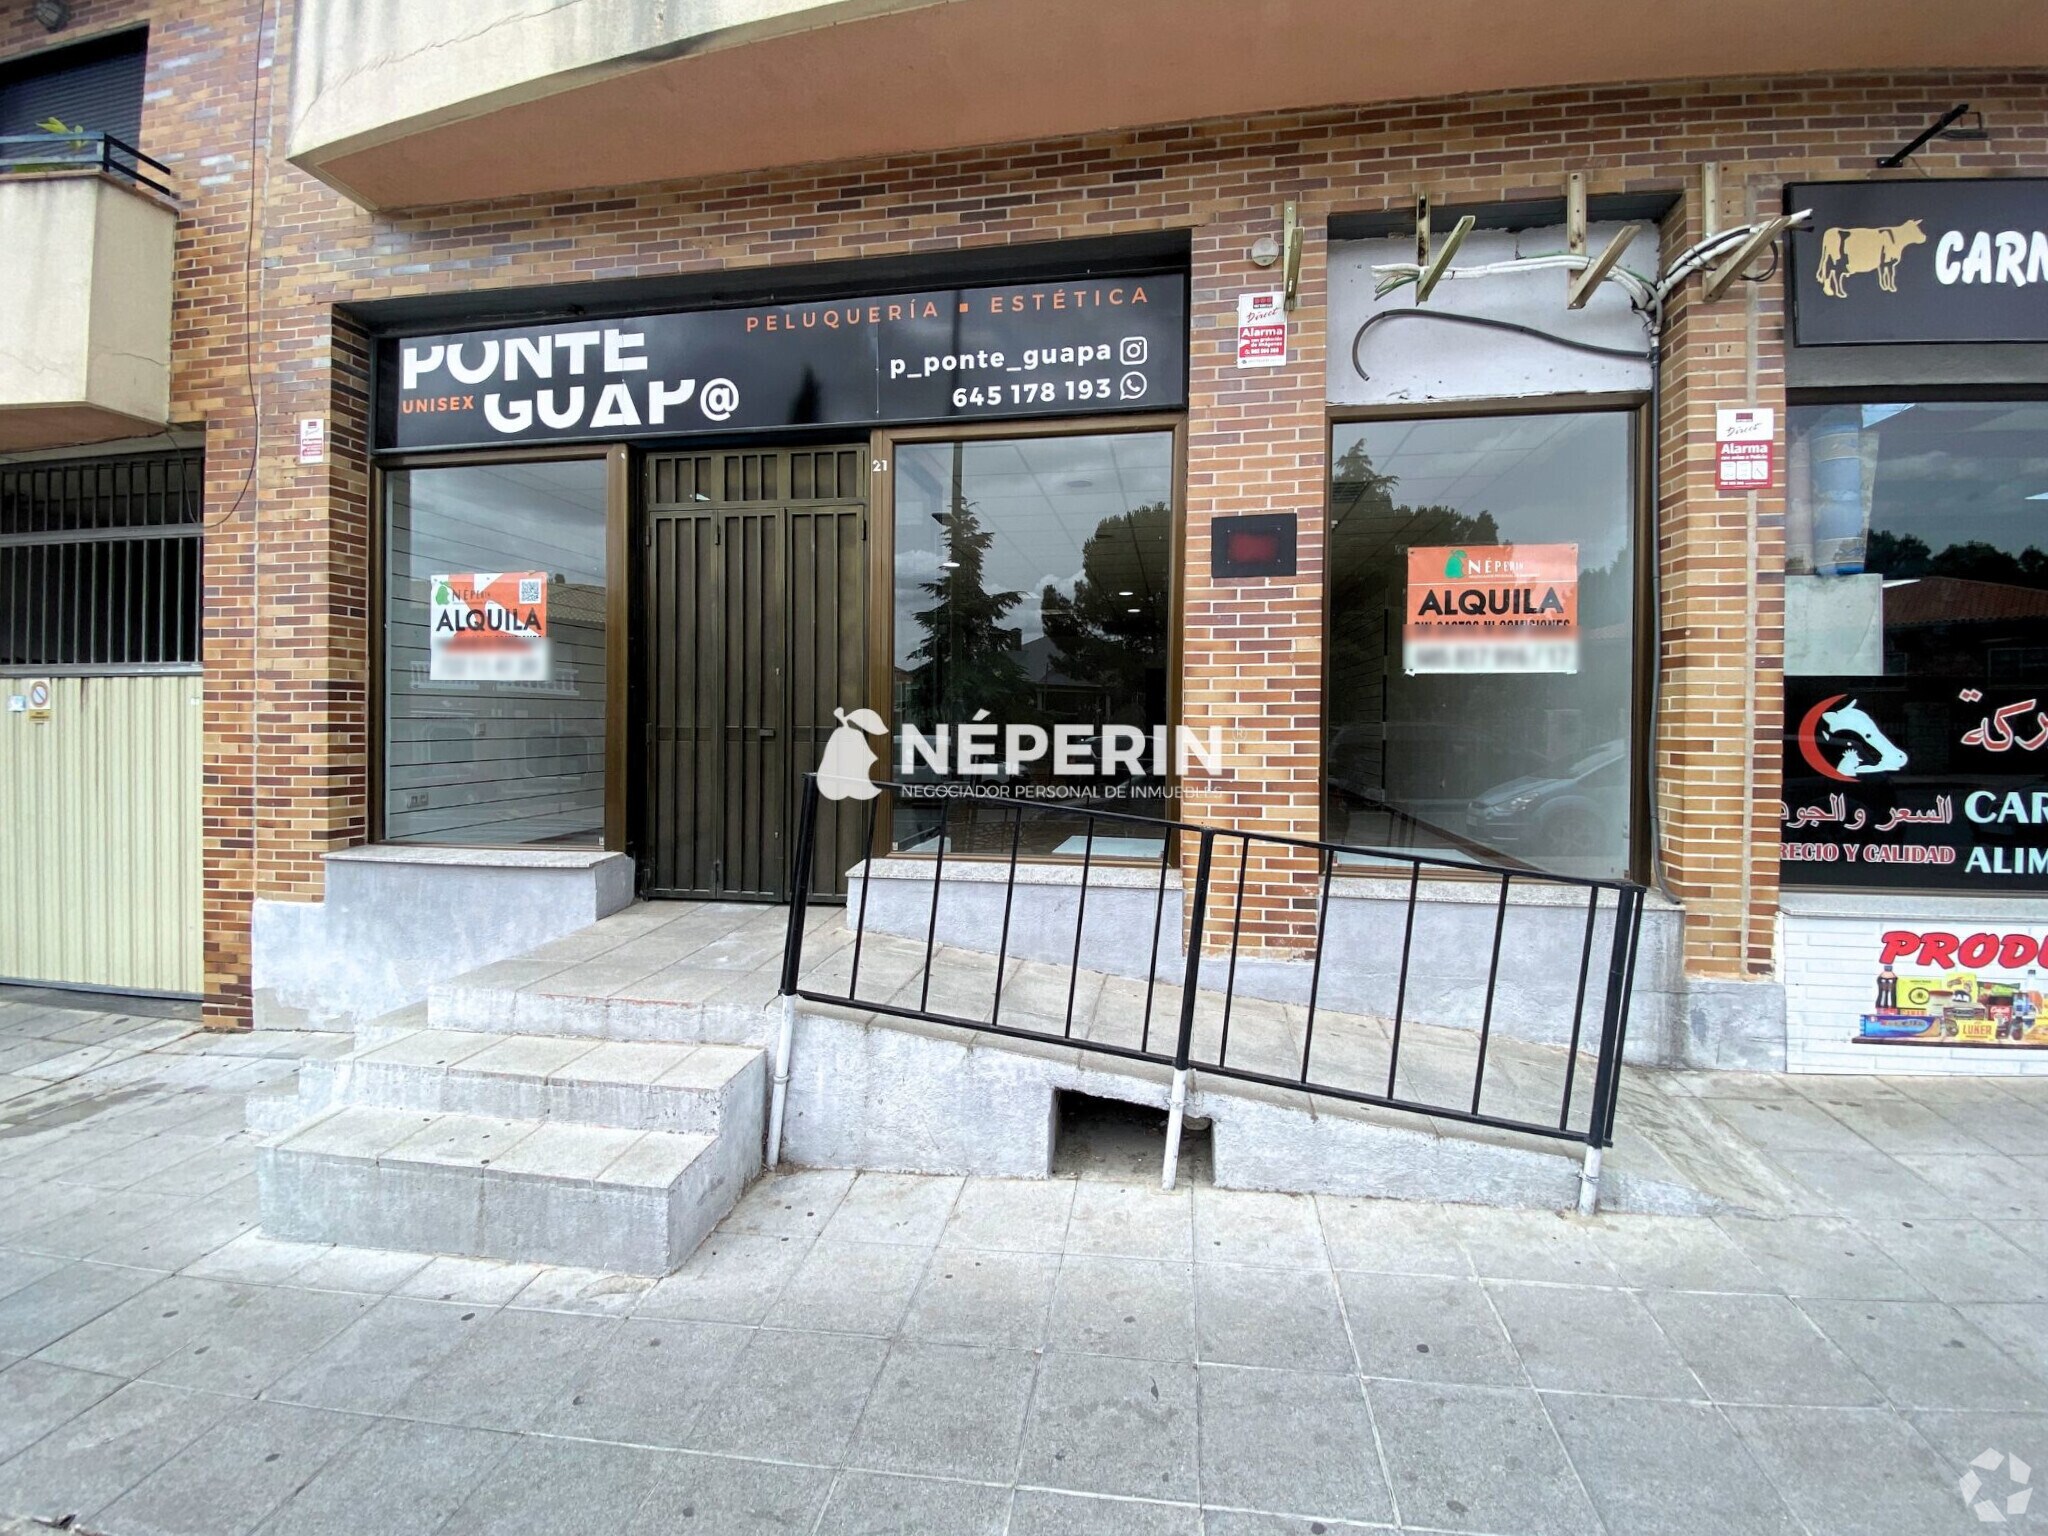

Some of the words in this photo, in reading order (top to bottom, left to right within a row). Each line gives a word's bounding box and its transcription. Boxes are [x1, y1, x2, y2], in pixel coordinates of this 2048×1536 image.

[1934, 230, 2048, 288] CARN
[746, 299, 938, 332] PELUQUERÍA
[990, 287, 1148, 313] ESTÉTICA
[1241, 328, 1283, 337] Alarma
[402, 328, 648, 390] PONTE
[890, 343, 1112, 379] p_ponte_guapa
[402, 395, 474, 414] UNISEX
[483, 378, 740, 433] GUAP@
[952, 386, 1002, 408] 645
[1010, 383, 1056, 404] 178
[1065, 378, 1112, 401] 193
[1720, 443, 1768, 454] Alarma
[872, 459, 888, 472] 21
[1468, 557, 1524, 574] NÉPERIN
[1418, 587, 1564, 615] ALQUILA
[436, 608, 542, 632] ALQUILA
[1874, 795, 1953, 831] السعر
[1964, 790, 2048, 824] CAR
[1843, 843, 1860, 862] Y
[1863, 843, 1956, 864] CALIDAD
